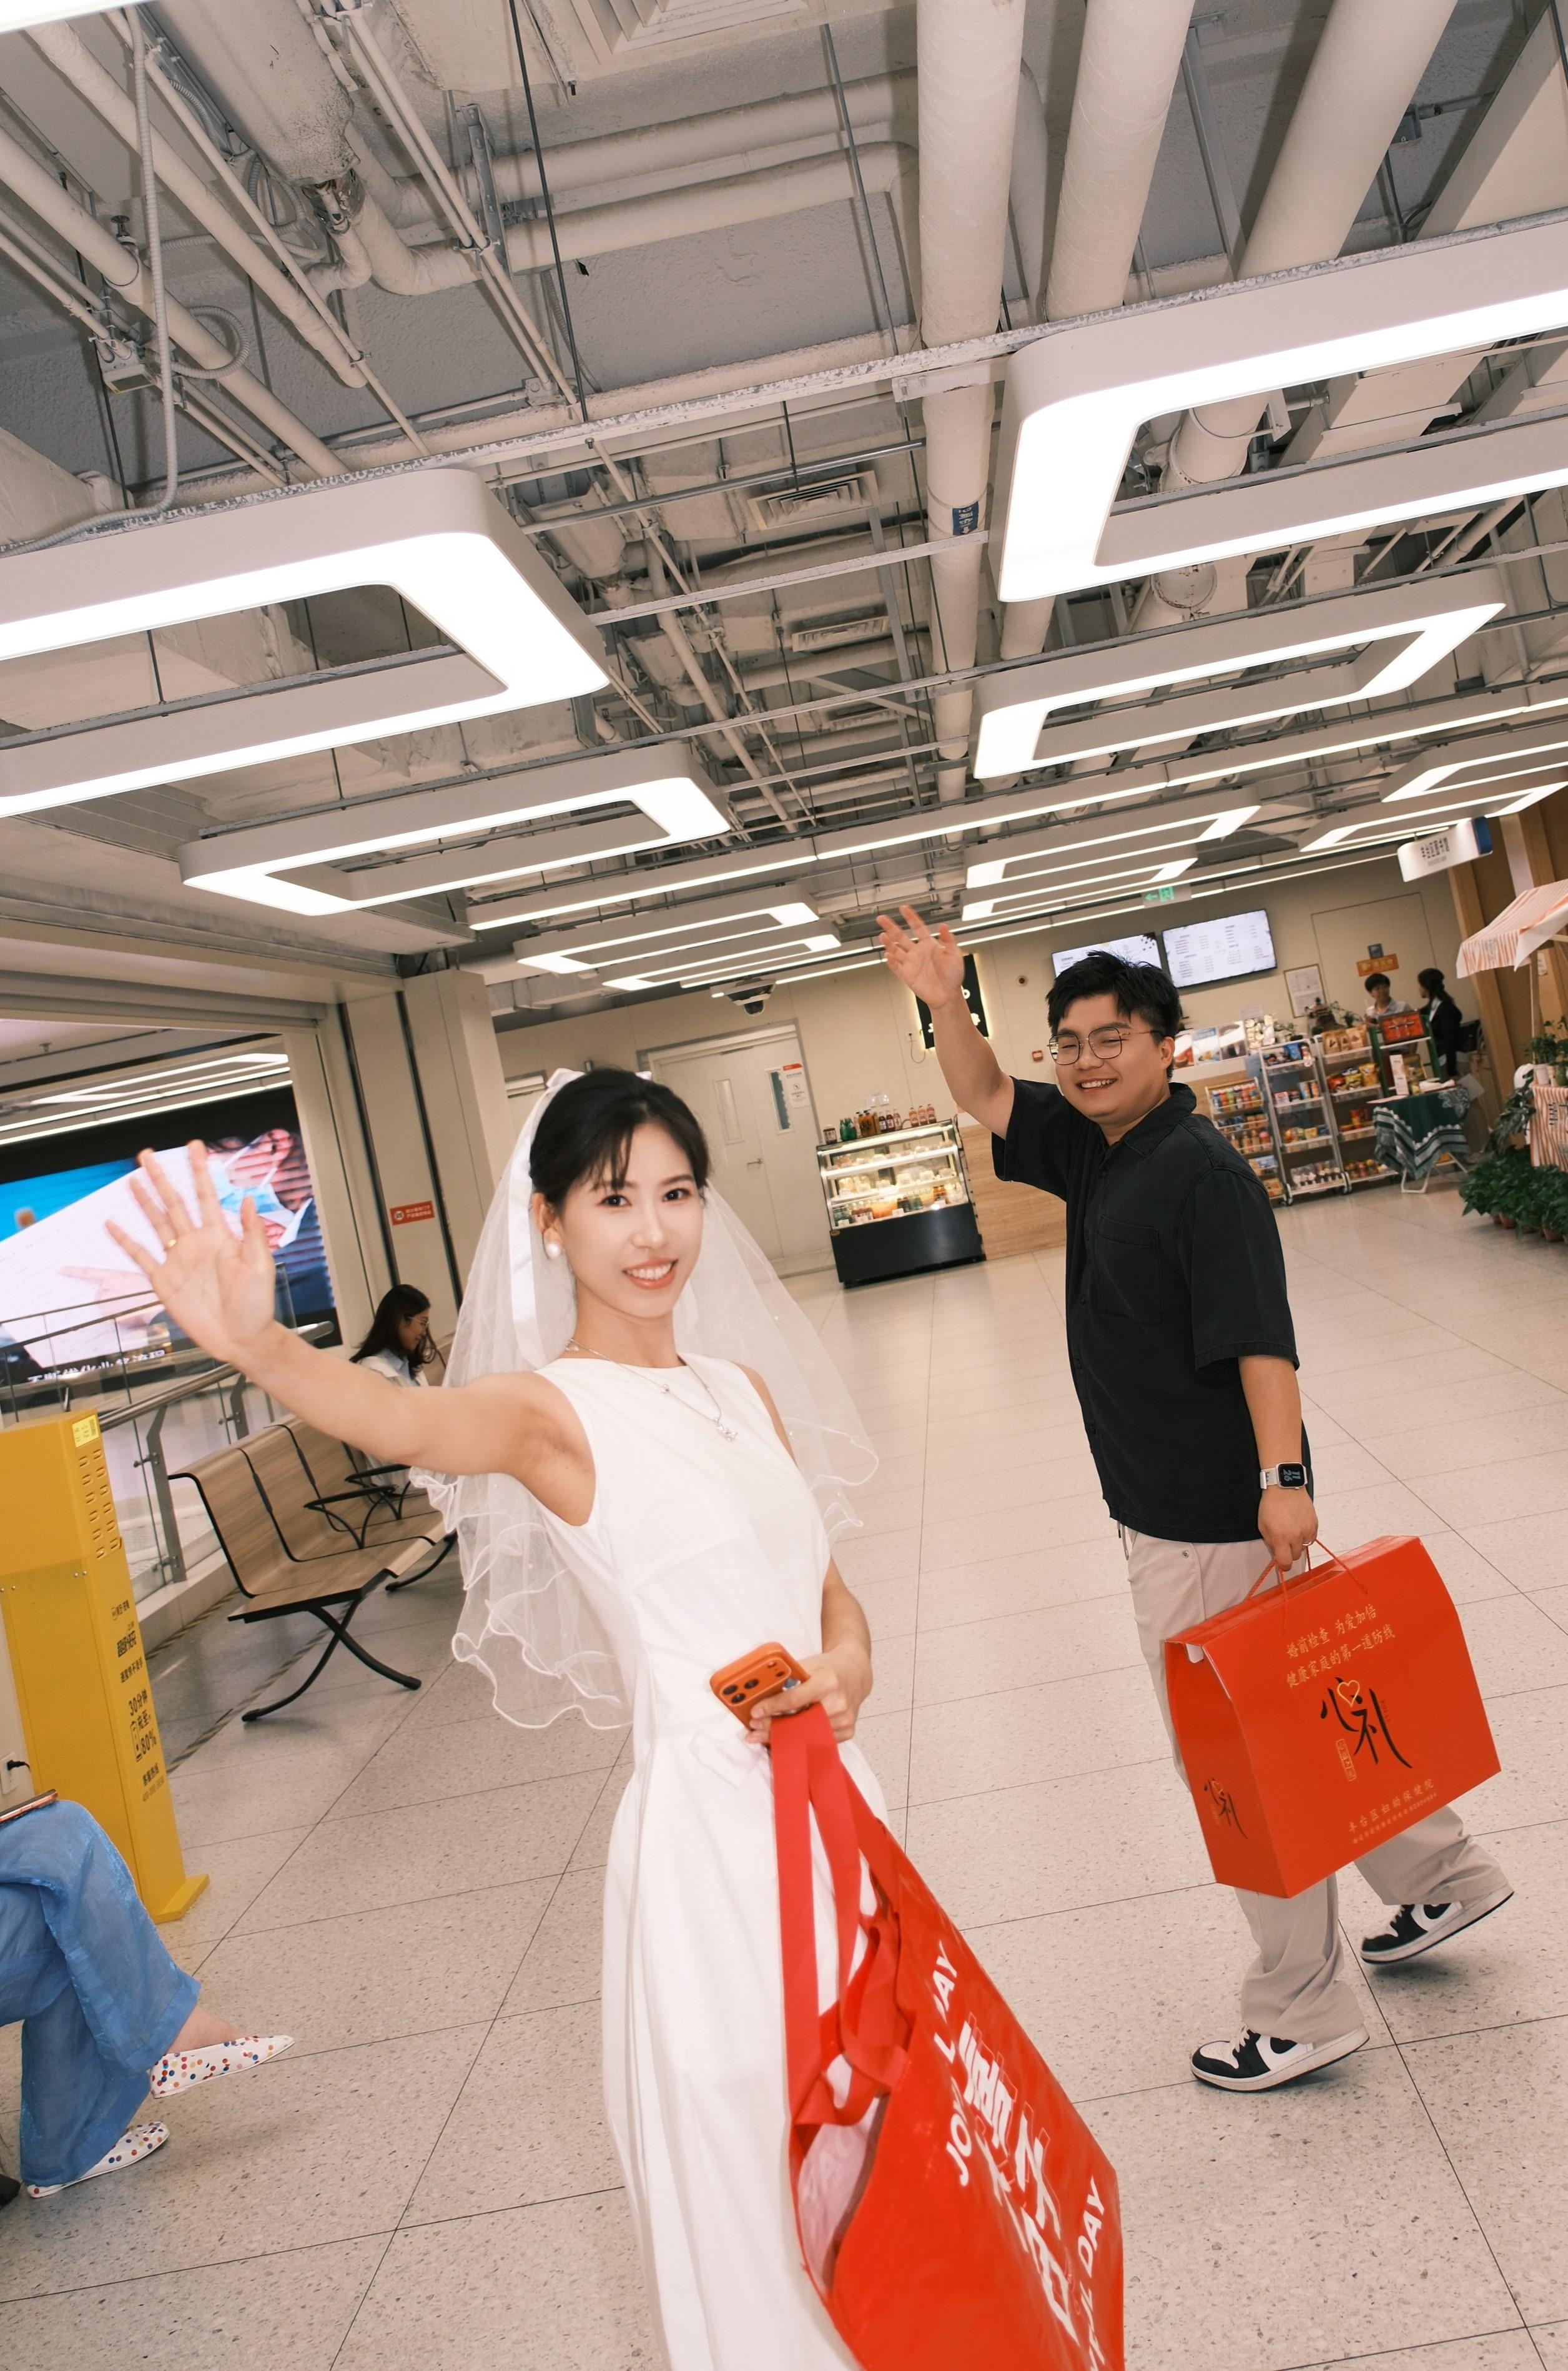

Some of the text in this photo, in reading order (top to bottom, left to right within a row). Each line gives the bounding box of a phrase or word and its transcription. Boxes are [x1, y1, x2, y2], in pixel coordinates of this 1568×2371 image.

[1286, 1604, 1377, 1659] 婚前检查 为爱加倍
[1286, 1624, 1396, 1688] 健康家庭的第一道防线
[141, 1728, 157, 1755] 80%
[1349, 1778, 1434, 1834] 丰台区妇幼保健院
[1077, 2174, 1105, 2278] DAY
